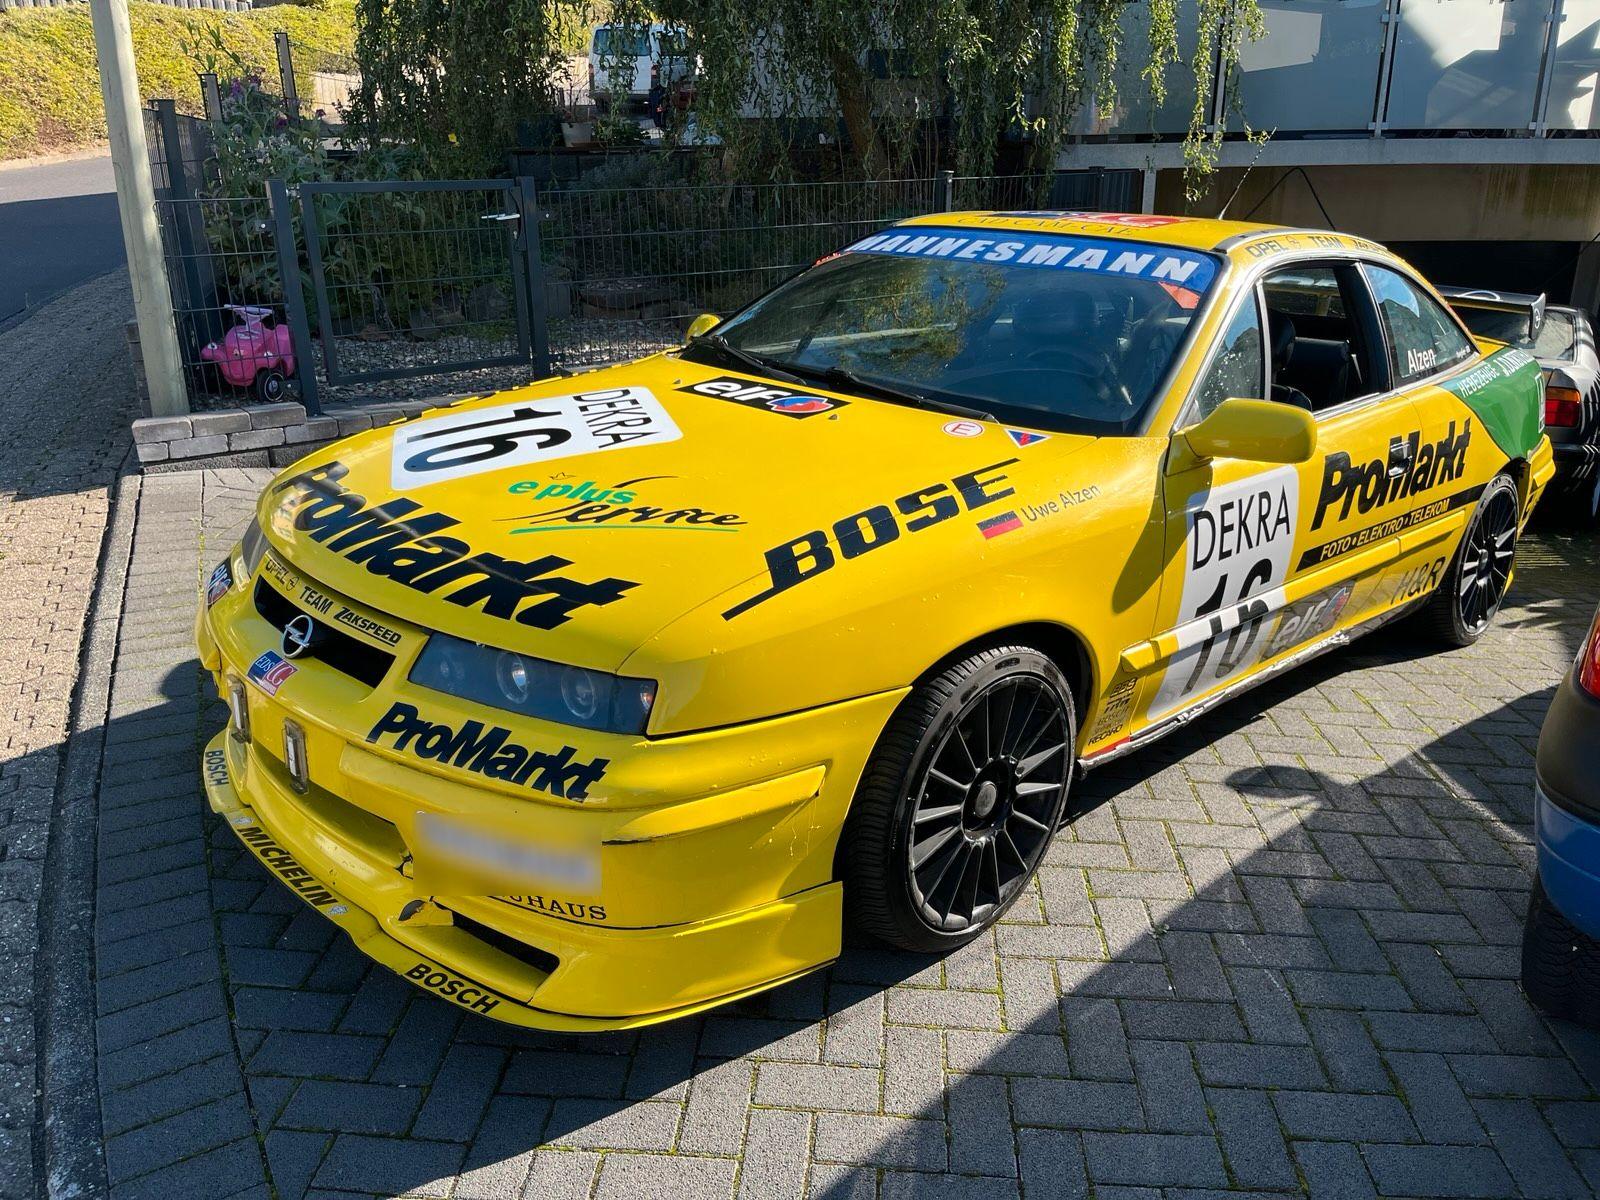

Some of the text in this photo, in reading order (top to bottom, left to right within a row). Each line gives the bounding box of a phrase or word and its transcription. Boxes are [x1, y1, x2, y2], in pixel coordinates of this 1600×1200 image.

[844, 234, 1200, 283] MANNESMANN
[693, 381, 793, 401] elf
[1407, 348, 1436, 374] Alzen
[403, 407, 572, 473] 16
[572, 388, 660, 449] DEKRA
[1021, 484, 1101, 522] Uwe Alzen
[1310, 416, 1471, 532] ProMarkt
[272, 460, 644, 631] ProMarkt
[721, 457, 1021, 621] BOSE
[1192, 484, 1291, 571] DEKRA
[265, 558, 402, 647] OPEL TEAM ZAKSPEED
[1180, 557, 1273, 698] 16
[1271, 598, 1329, 651] elf
[205, 749, 230, 787] BOSCH
[365, 701, 610, 804] ProMarkt
[236, 825, 339, 907] MICHELIN
[403, 963, 500, 1015] BOSCH
